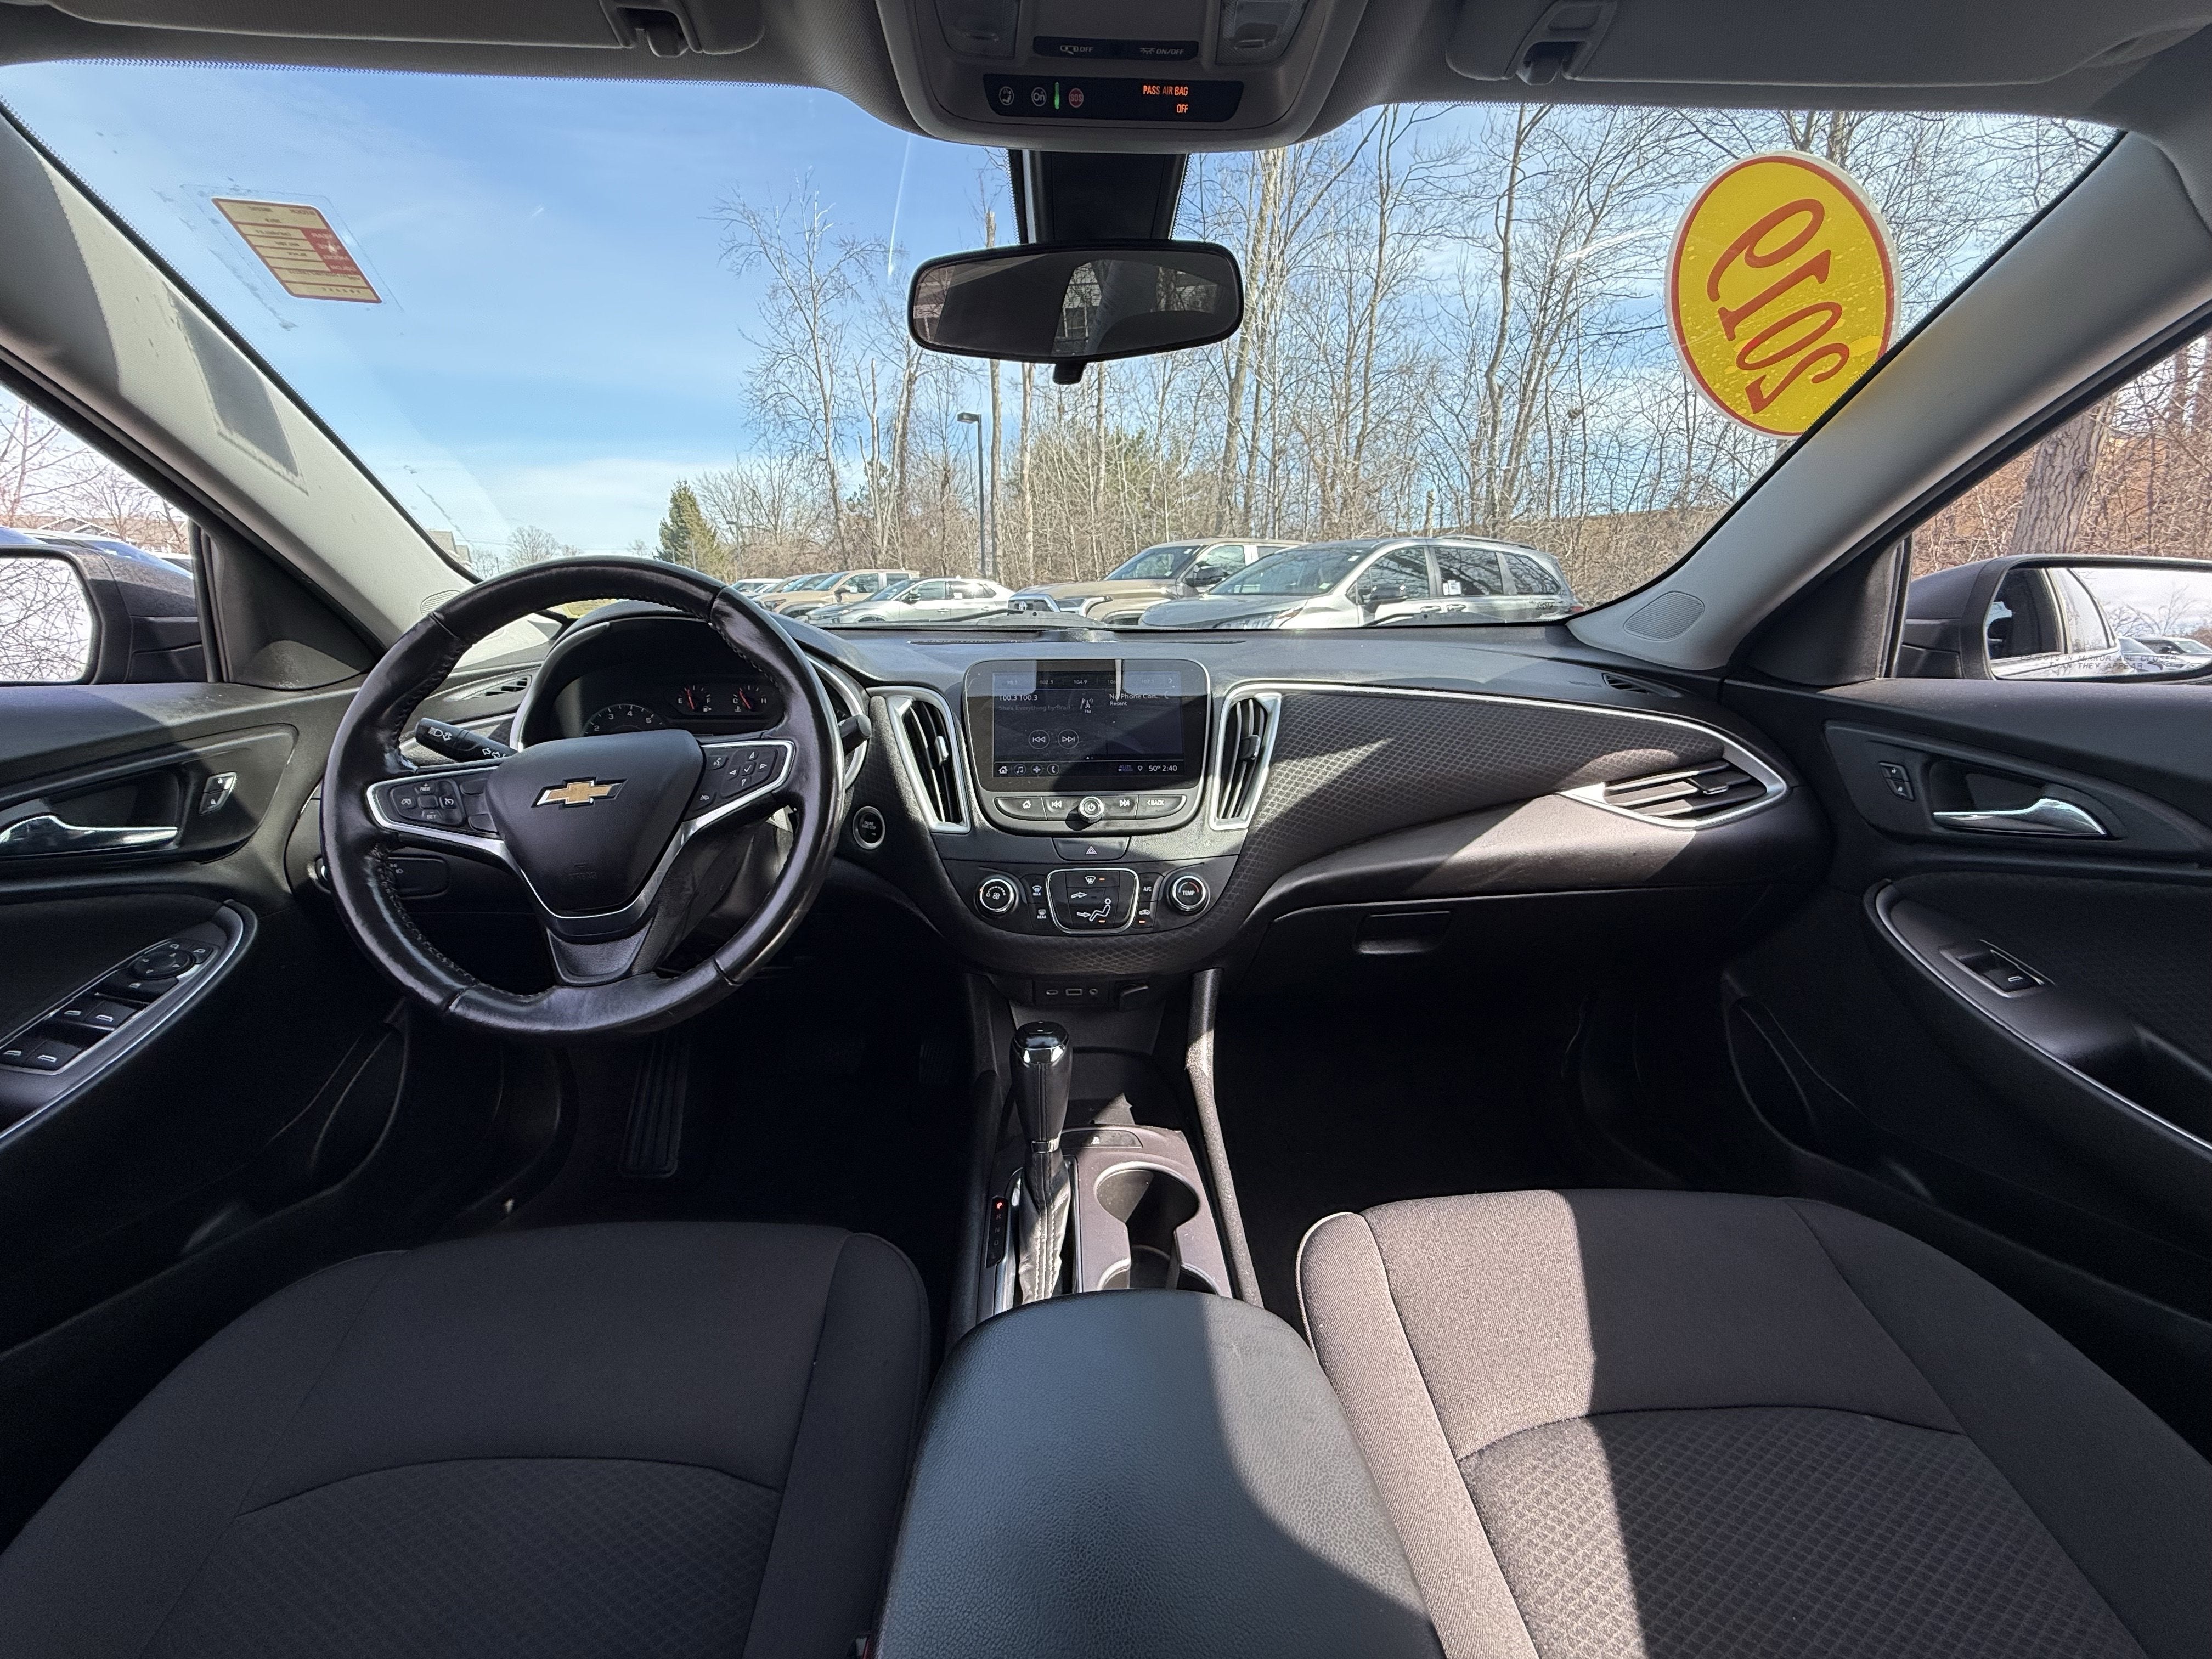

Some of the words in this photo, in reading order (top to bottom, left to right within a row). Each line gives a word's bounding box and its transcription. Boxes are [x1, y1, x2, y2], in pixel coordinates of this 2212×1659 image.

[1143, 85, 1160, 95] PASS
[1162, 86, 1173, 95] AIR
[1174, 86, 1188, 96] BAG
[1070, 94, 1082, 103] SOS
[1176, 104, 1189, 114] OFF
